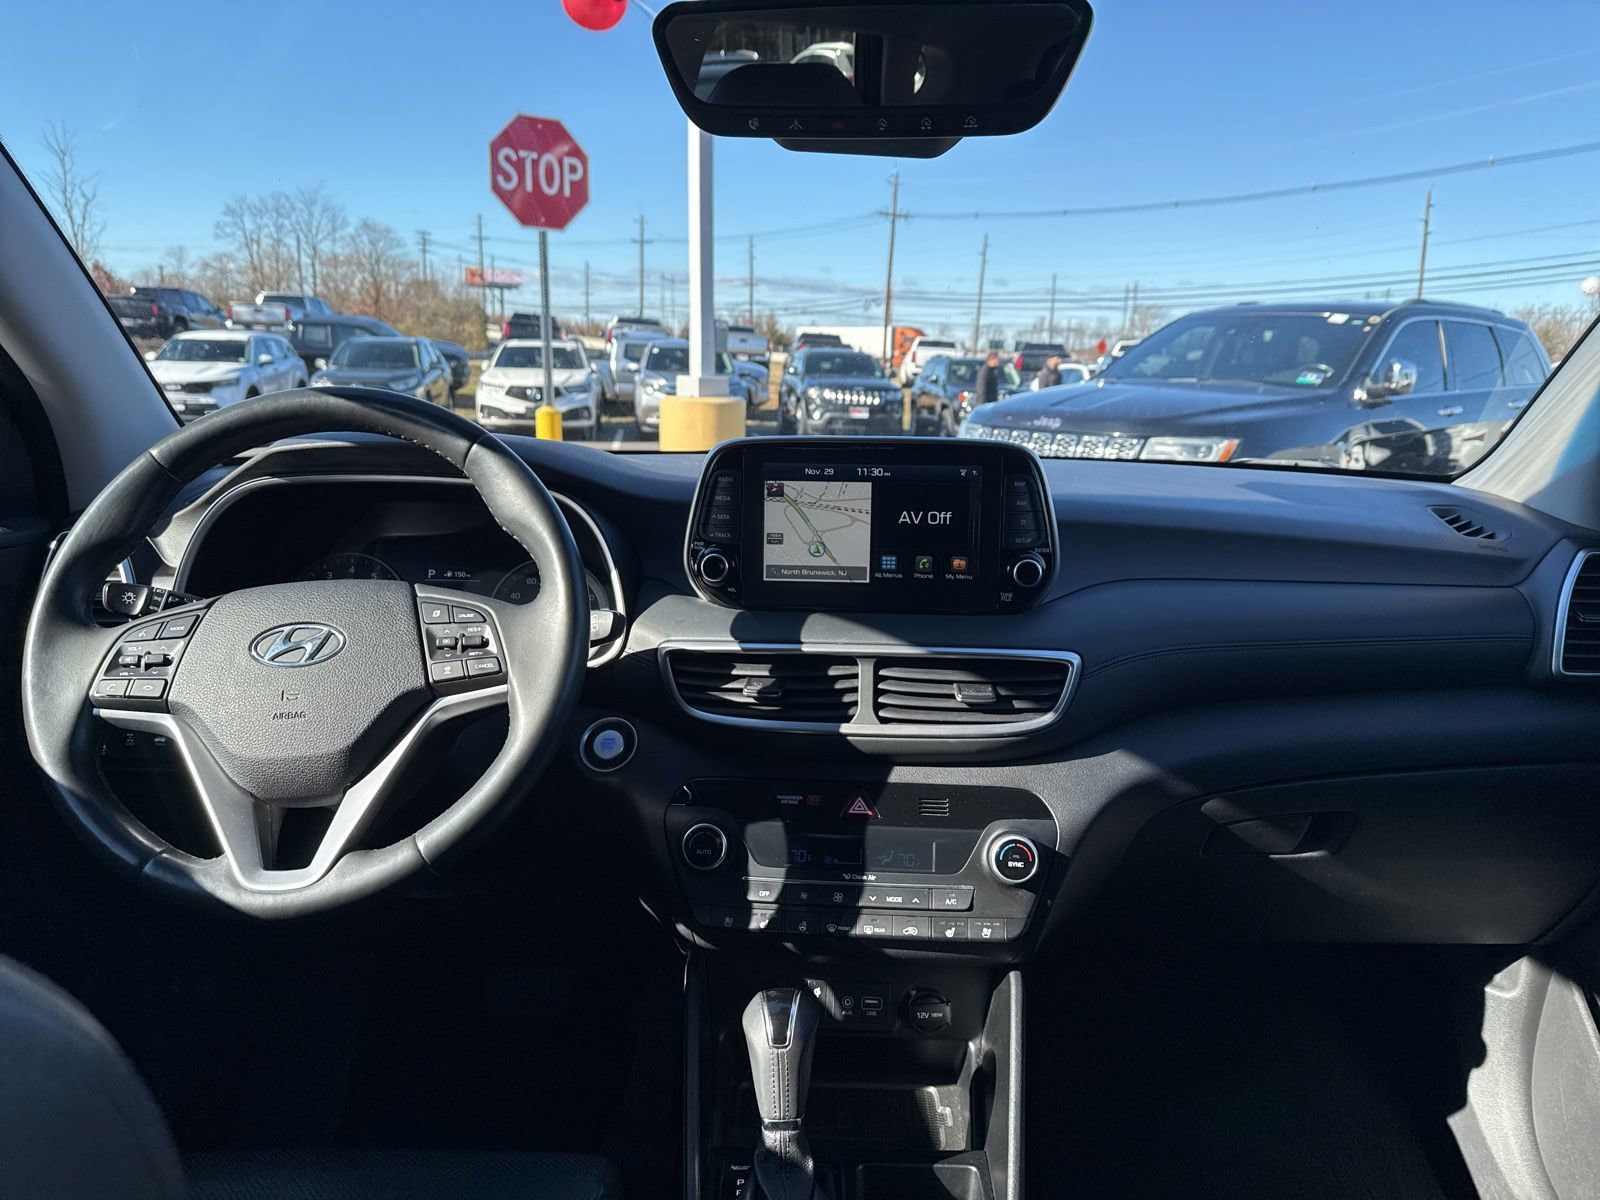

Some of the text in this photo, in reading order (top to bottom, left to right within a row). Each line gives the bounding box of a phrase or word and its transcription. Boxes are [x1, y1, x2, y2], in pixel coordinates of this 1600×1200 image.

[496, 147, 584, 197] STOP
[857, 468, 883, 476] 11:30
[898, 511, 952, 525] AV Off
[428, 569, 436, 578] P
[781, 568, 801, 576] North
[802, 568, 837, 577] Brunswick,
[272, 711, 306, 720] AIRBAG
